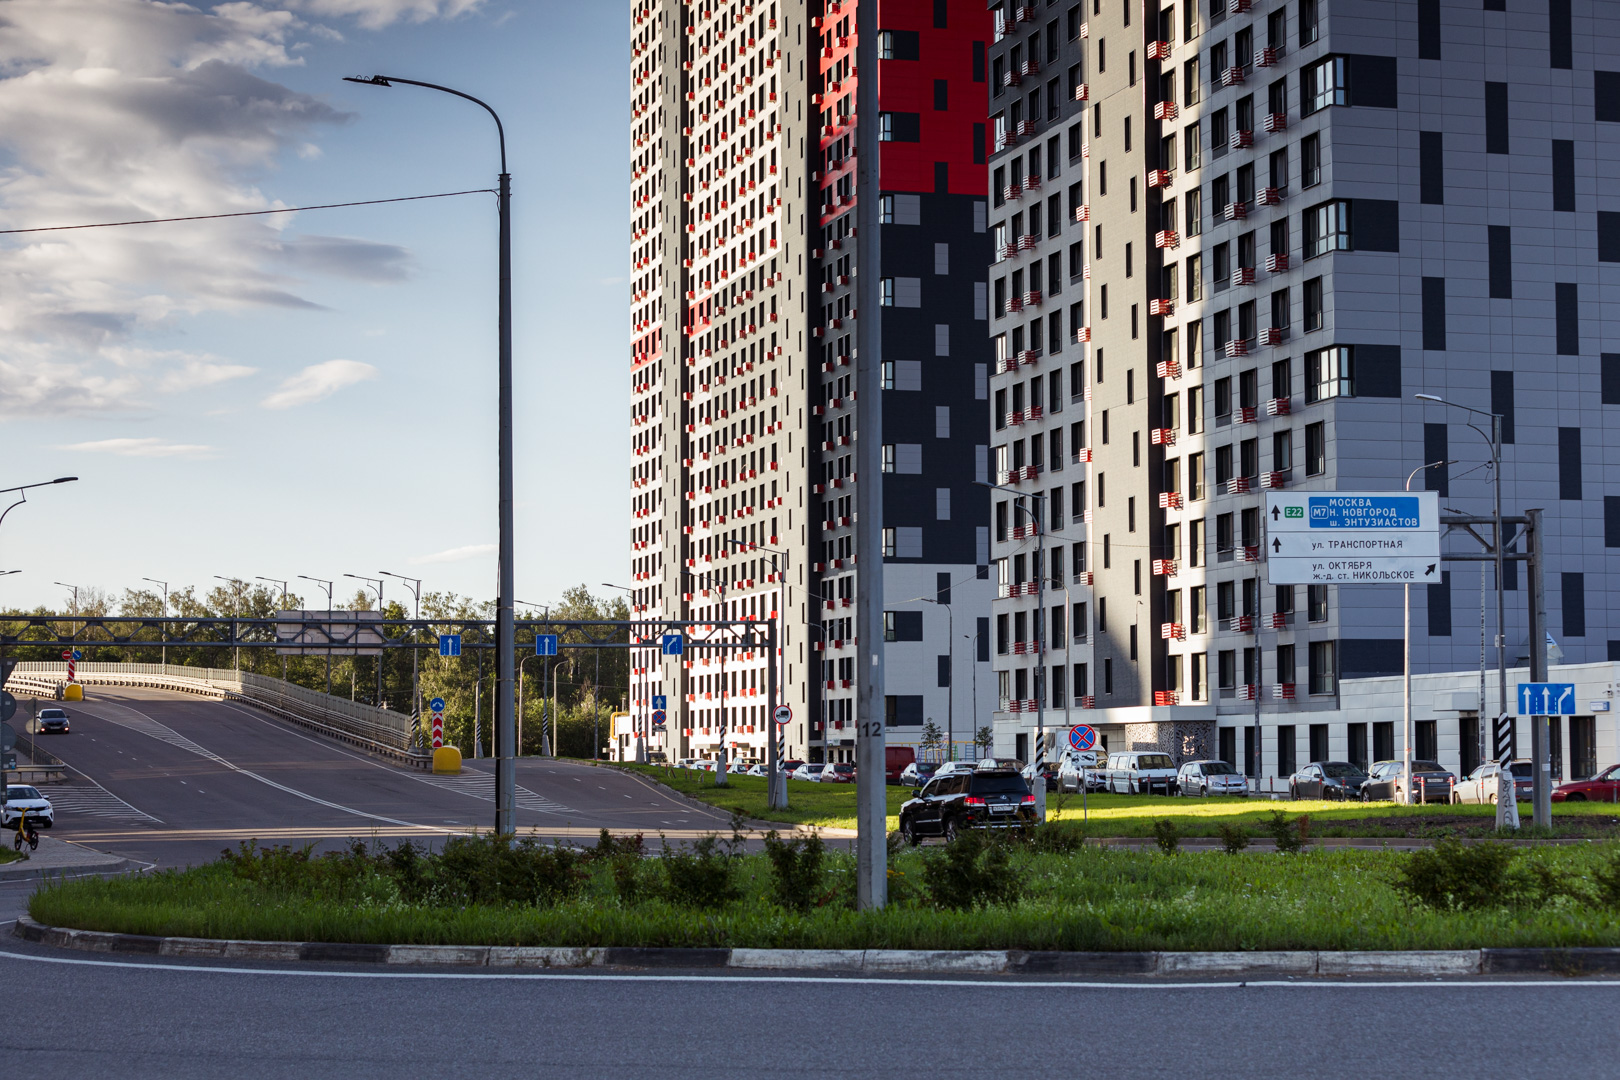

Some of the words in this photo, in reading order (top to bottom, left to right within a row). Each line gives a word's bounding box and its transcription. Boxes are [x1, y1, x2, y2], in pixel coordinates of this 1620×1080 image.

[1329, 498, 1372, 507] МОСКВА
[1285, 507, 1303, 517] E22
[1329, 508, 1339, 517] Н.
[1342, 508, 1397, 518] НОВГОРОД
[1329, 519, 1341, 527] ш.
[1344, 518, 1418, 527] ЭНТУЗИАСТОВ
[1311, 541, 1325, 551] ул.
[1328, 540, 1403, 549] ТРАНСПОРТНАЯ
[1312, 563, 1325, 572] ул.
[1328, 561, 1372, 570] ОКТЯБРЯ
[1312, 572, 1334, 581] ж.-д.
[1337, 572, 1350, 580] ст.
[1352, 571, 1415, 580] НИКОЛЬСКОЕ
